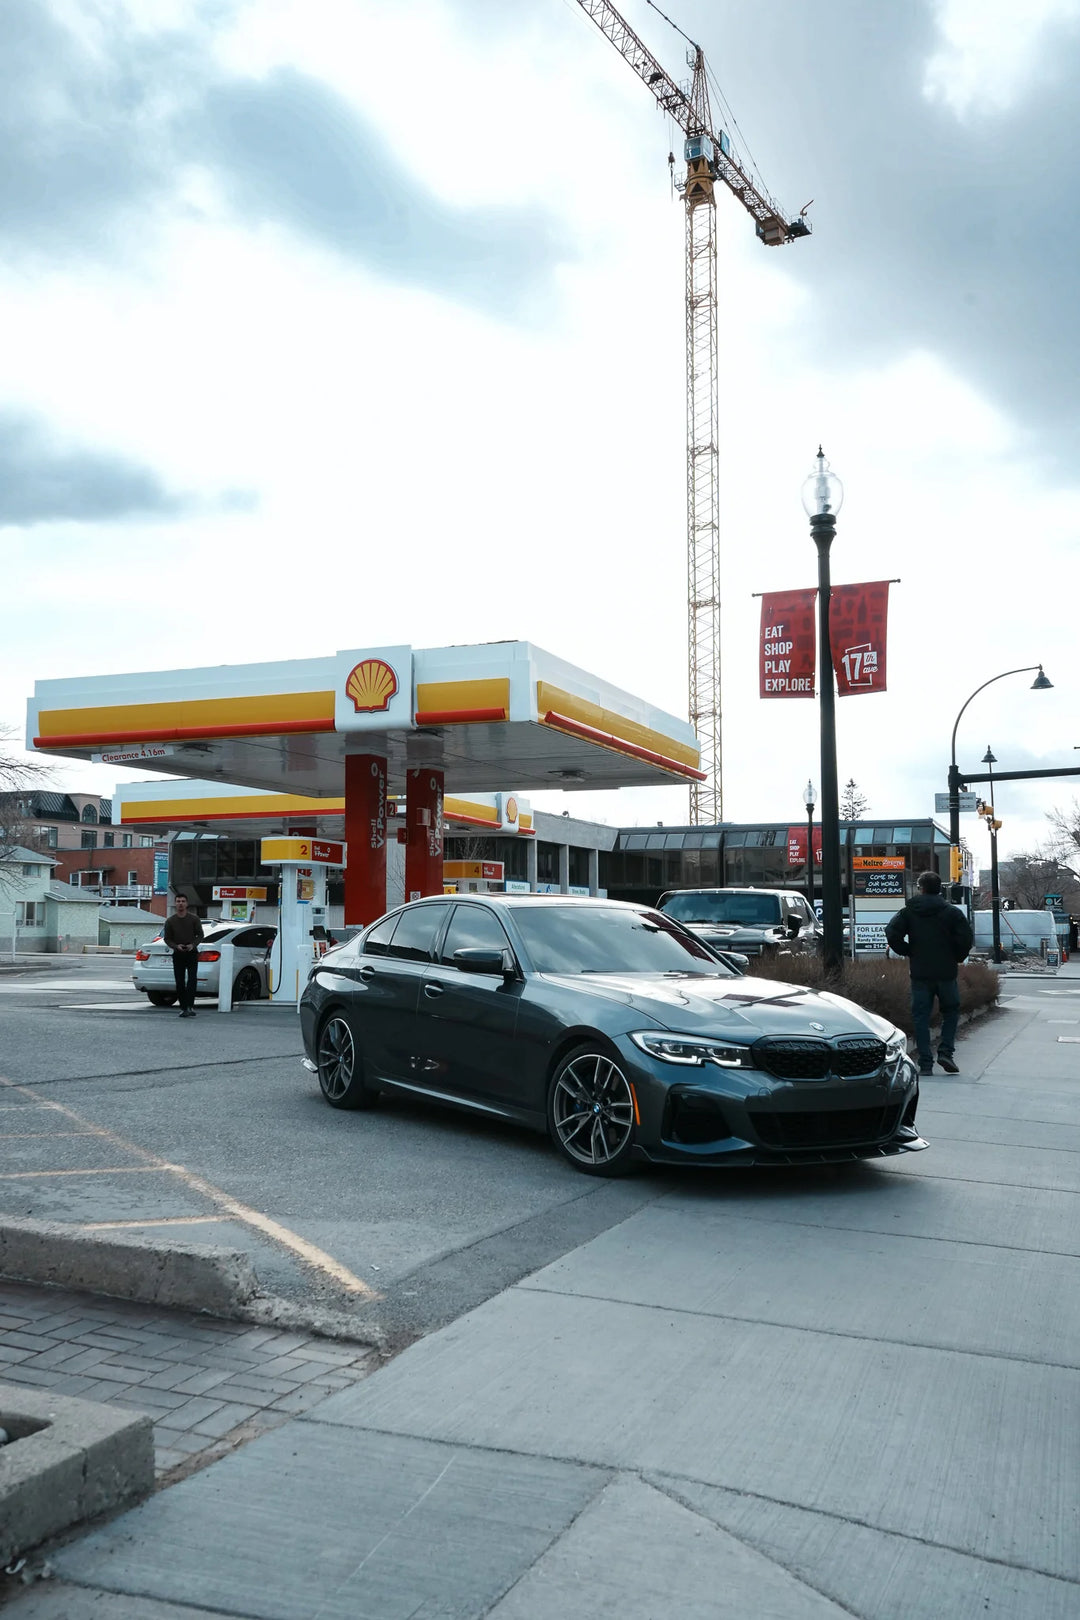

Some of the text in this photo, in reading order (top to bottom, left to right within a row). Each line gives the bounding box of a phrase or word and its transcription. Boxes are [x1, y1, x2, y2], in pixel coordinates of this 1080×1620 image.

[765, 625, 784, 639] EAT
[765, 642, 793, 656] SHOP
[765, 660, 791, 673] PLAY
[765, 678, 811, 691] EXPLORE
[102, 748, 166, 762] Clearance 4.16m
[377, 771, 385, 849] V-Power
[389, 803, 395, 815] 2
[435, 784, 443, 857] V-Power
[300, 844, 308, 855] 2
[474, 866, 480, 874] 4
[816, 908, 823, 917] P
